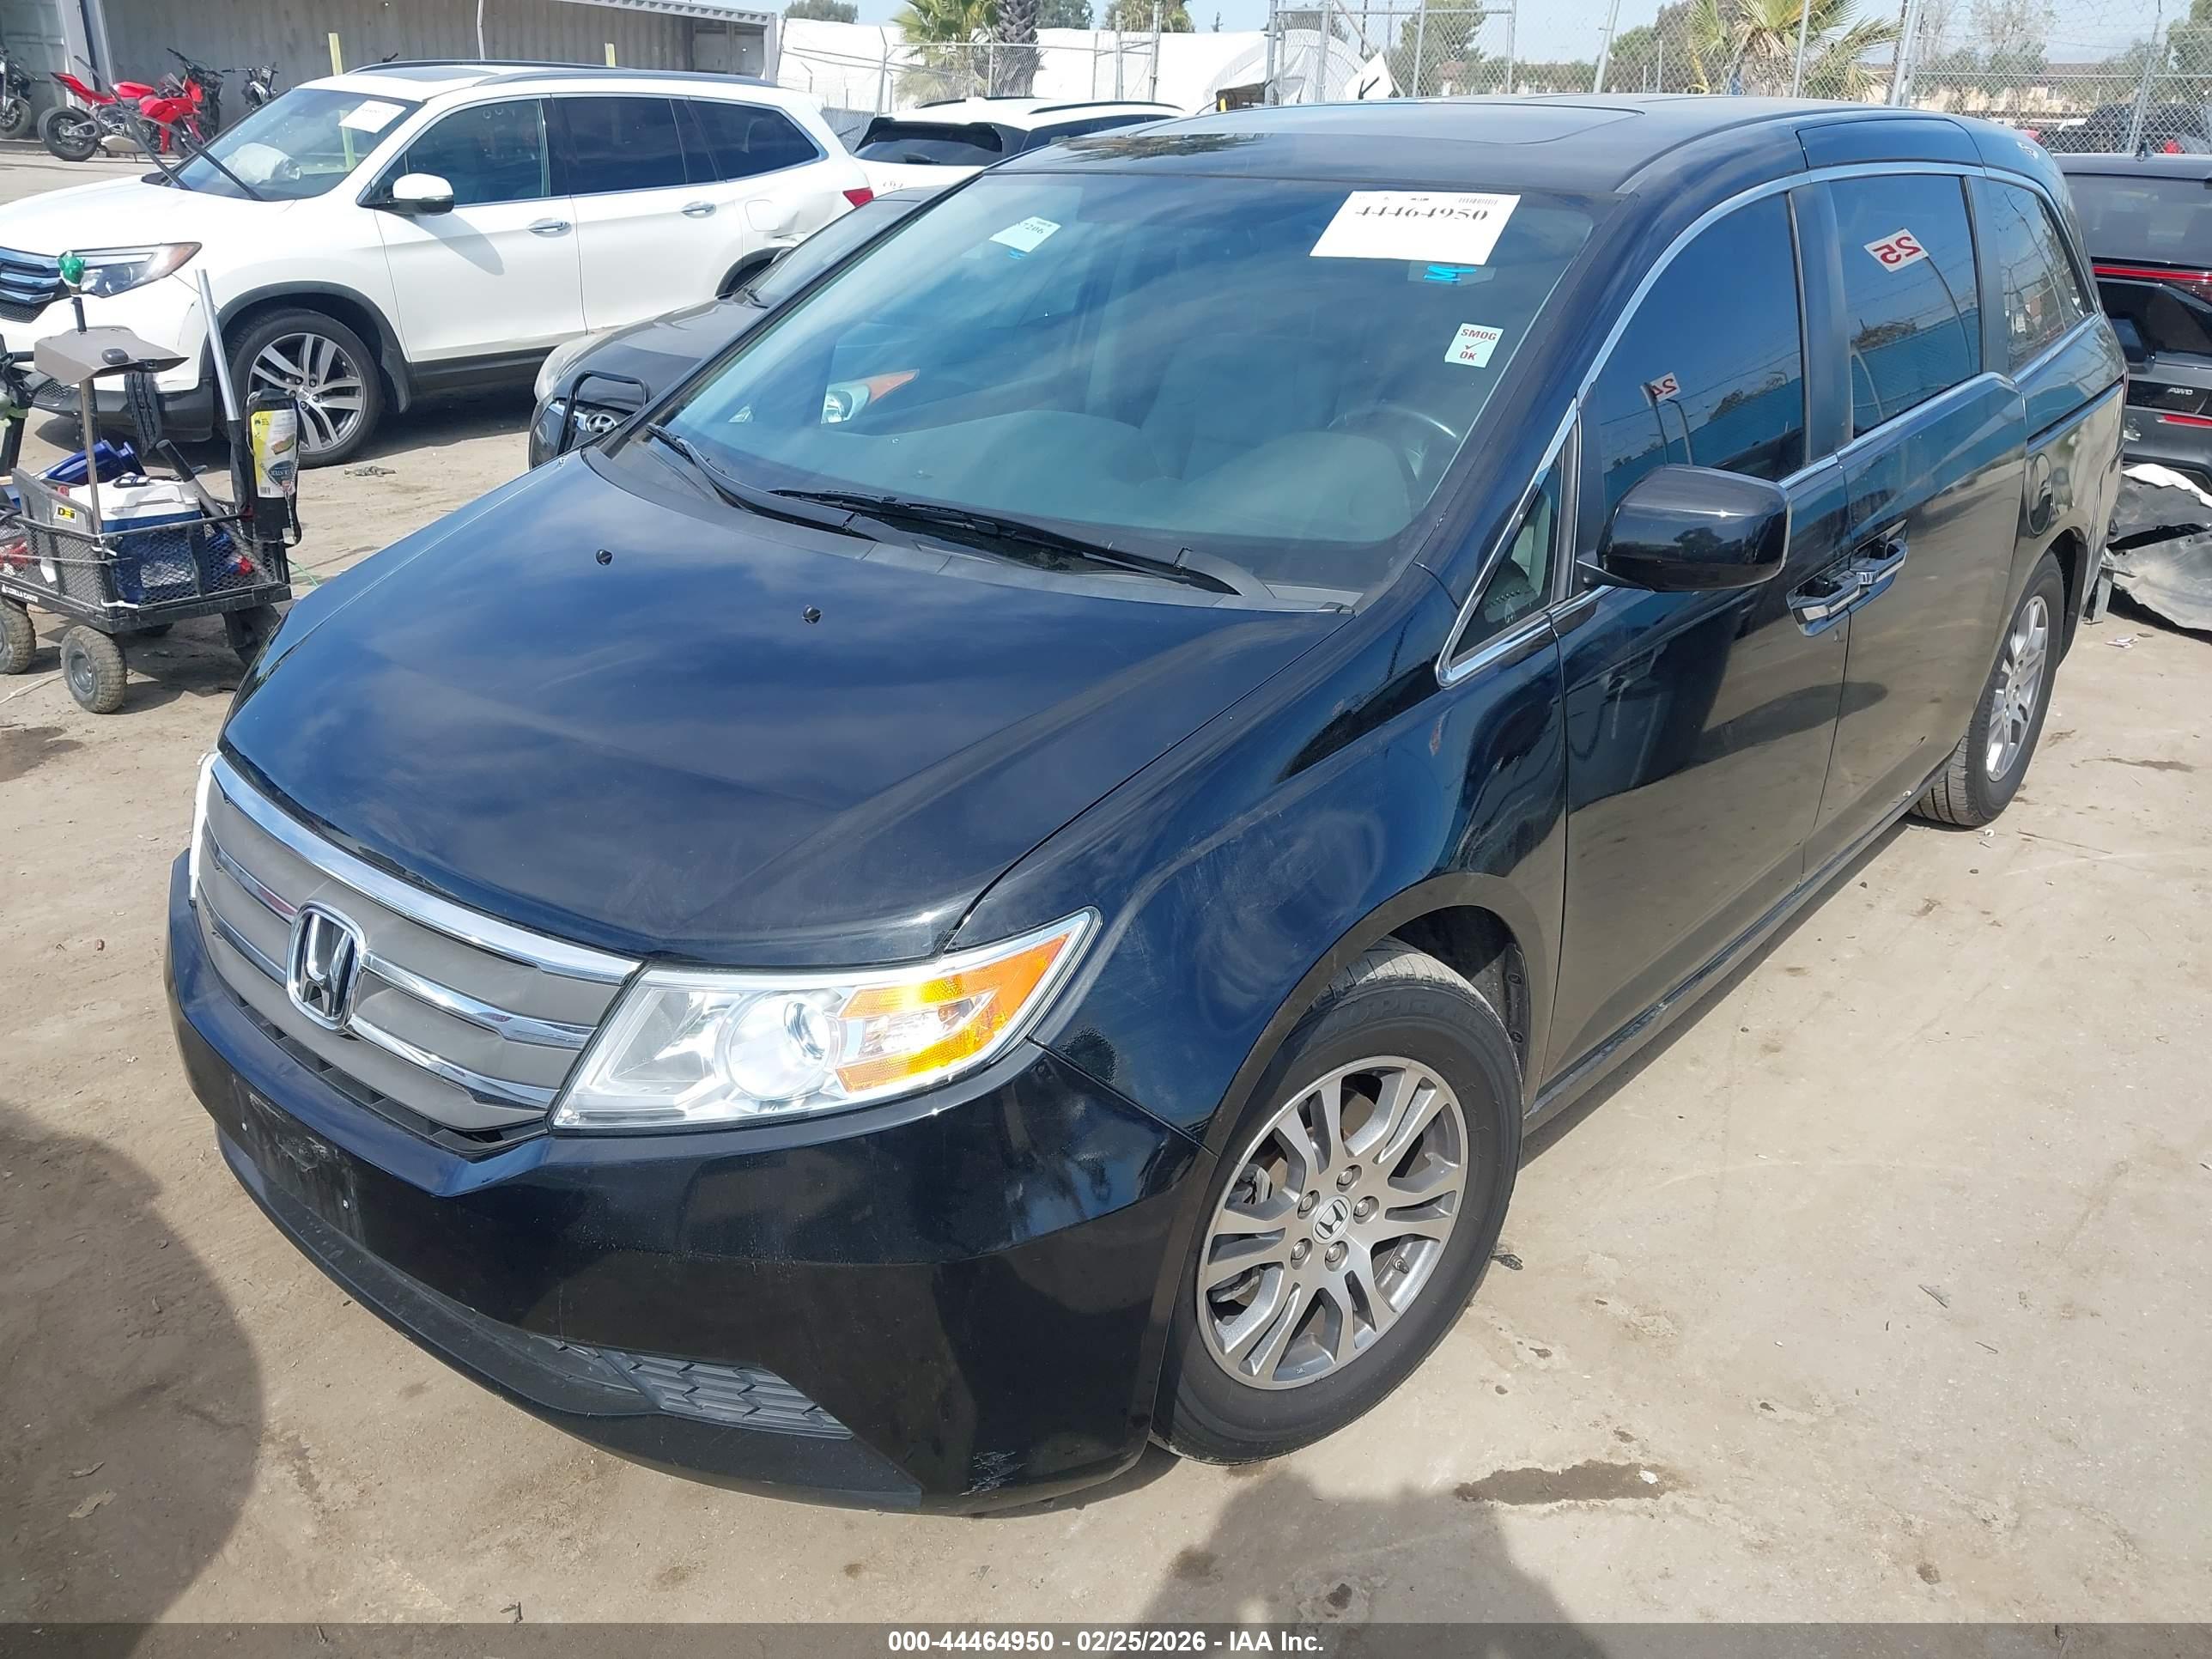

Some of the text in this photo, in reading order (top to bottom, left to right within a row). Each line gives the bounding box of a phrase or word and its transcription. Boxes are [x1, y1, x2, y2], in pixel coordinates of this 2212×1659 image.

[1356, 205, 1489, 222] 44464950
[1460, 328, 1498, 341] SMOG
[1459, 350, 1478, 361] OK
[2166, 386, 2194, 396] AWD
